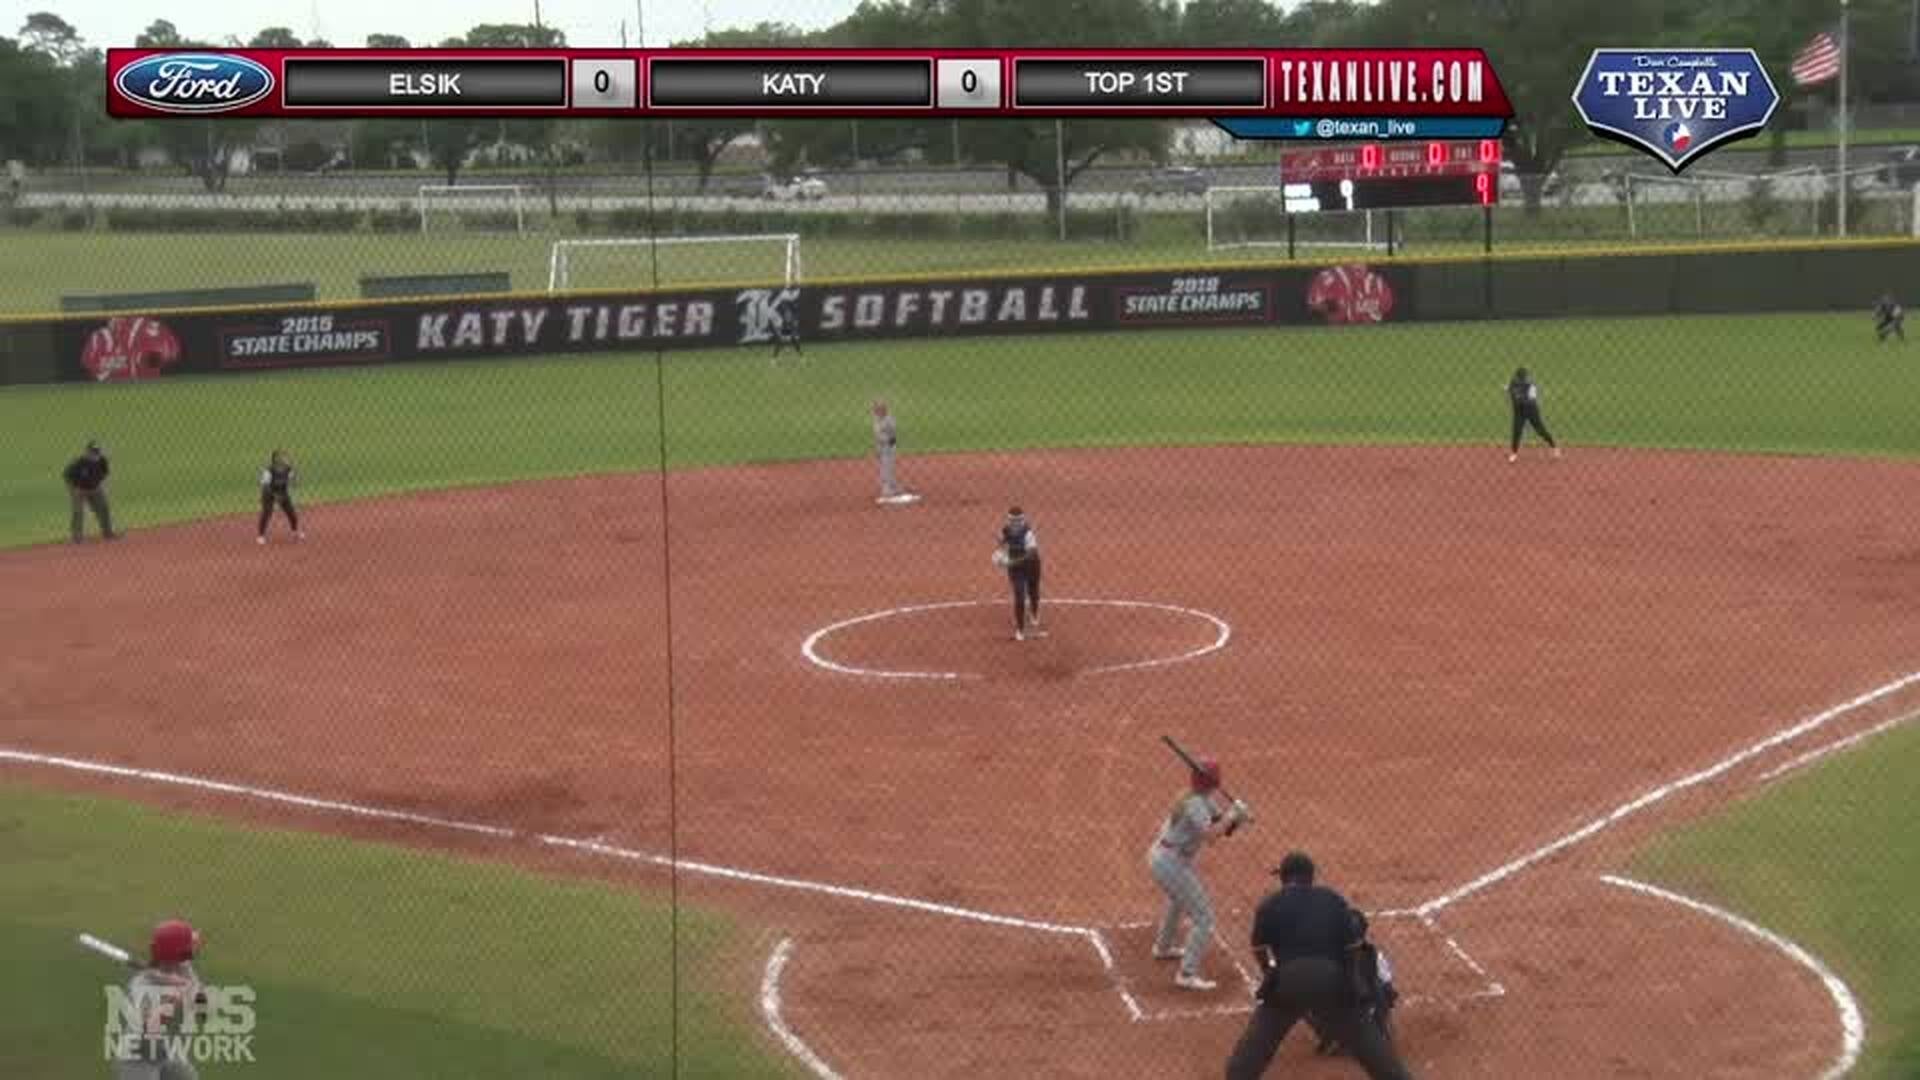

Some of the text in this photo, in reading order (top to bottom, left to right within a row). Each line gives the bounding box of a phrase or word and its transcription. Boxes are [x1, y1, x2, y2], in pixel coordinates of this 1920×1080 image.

[567, 301, 714, 341] TIGER
[820, 285, 1090, 329] SOFTBALL
[1125, 292, 1262, 314] STATE CHAMPS
[231, 331, 380, 356] STATE CHAMPS
[416, 308, 547, 349] KATY
